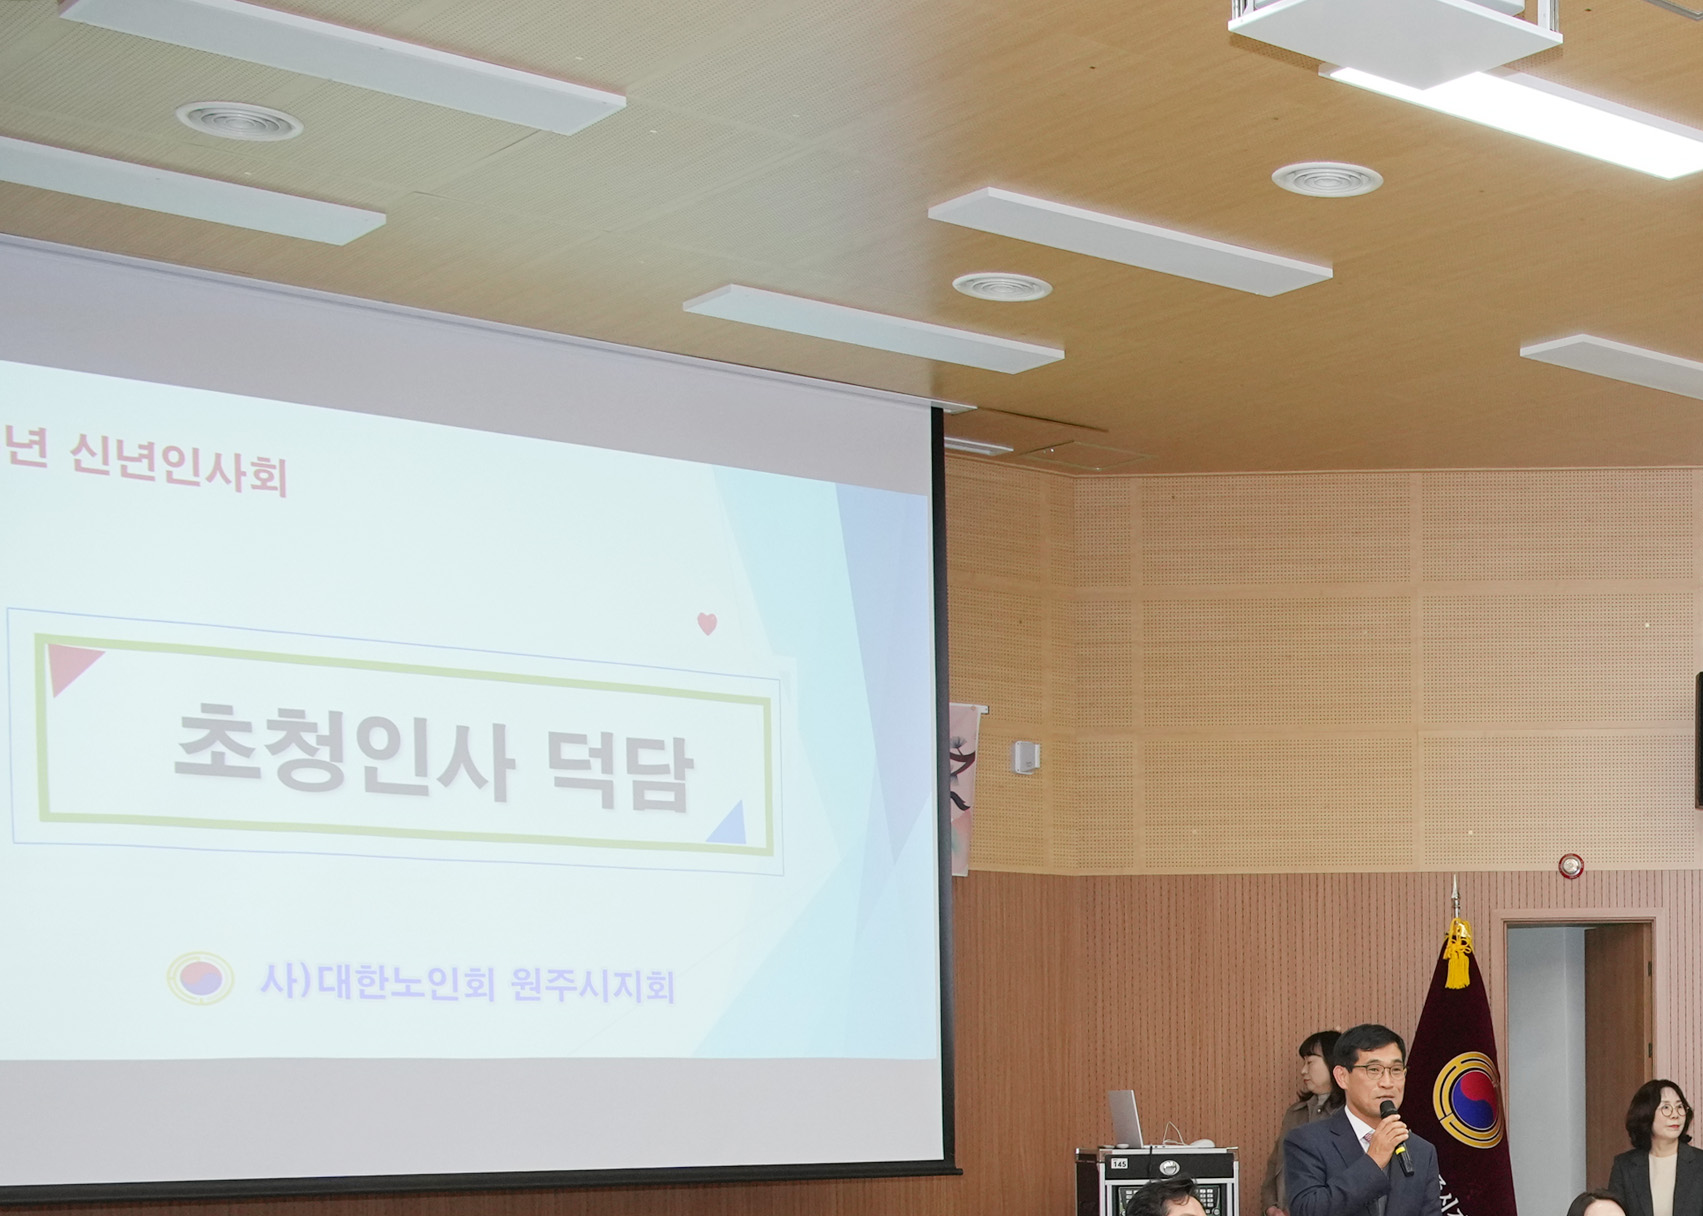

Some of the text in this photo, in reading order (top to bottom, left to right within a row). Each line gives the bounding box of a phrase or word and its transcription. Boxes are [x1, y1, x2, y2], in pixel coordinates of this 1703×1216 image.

[5, 425, 289, 498] 년 신년인사회
[174, 702, 696, 814] 초청인사 덕담
[260, 962, 676, 1005] 사)대한노인회 원주시지회
